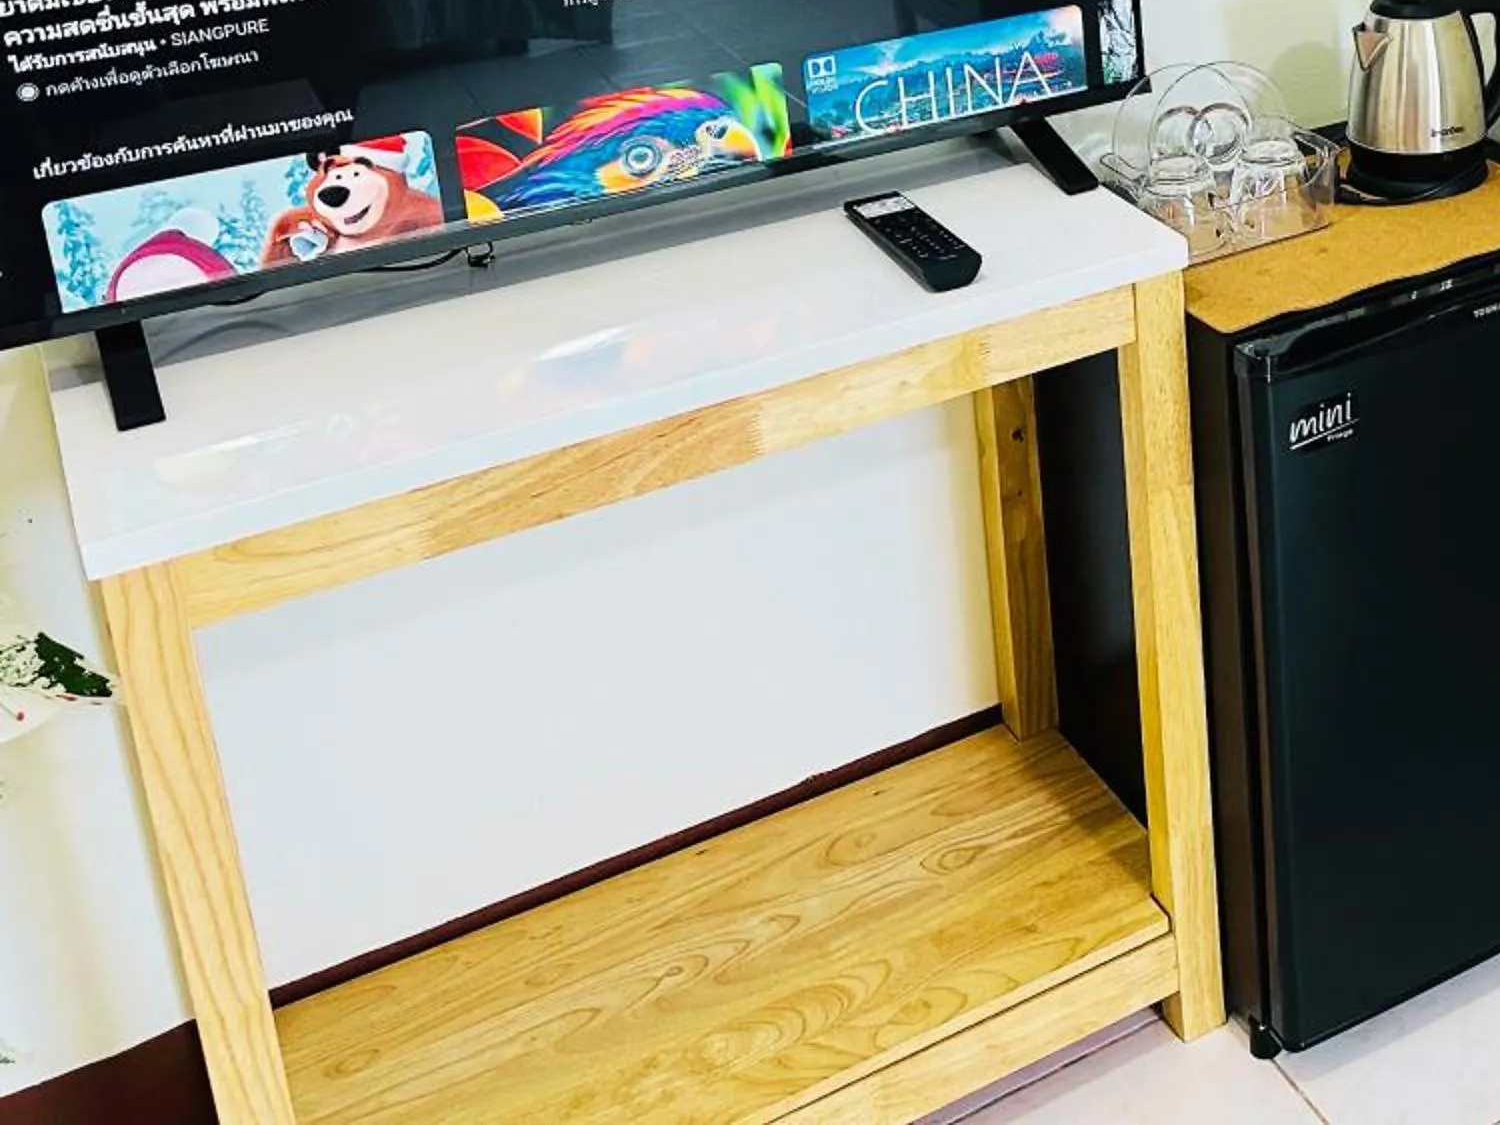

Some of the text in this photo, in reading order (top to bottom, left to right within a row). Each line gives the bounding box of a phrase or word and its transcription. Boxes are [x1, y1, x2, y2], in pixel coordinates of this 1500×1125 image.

[170, 18, 270, 47] SIANGPURE
[856, 51, 1052, 135] CHINA
[1289, 391, 1352, 444] mini
